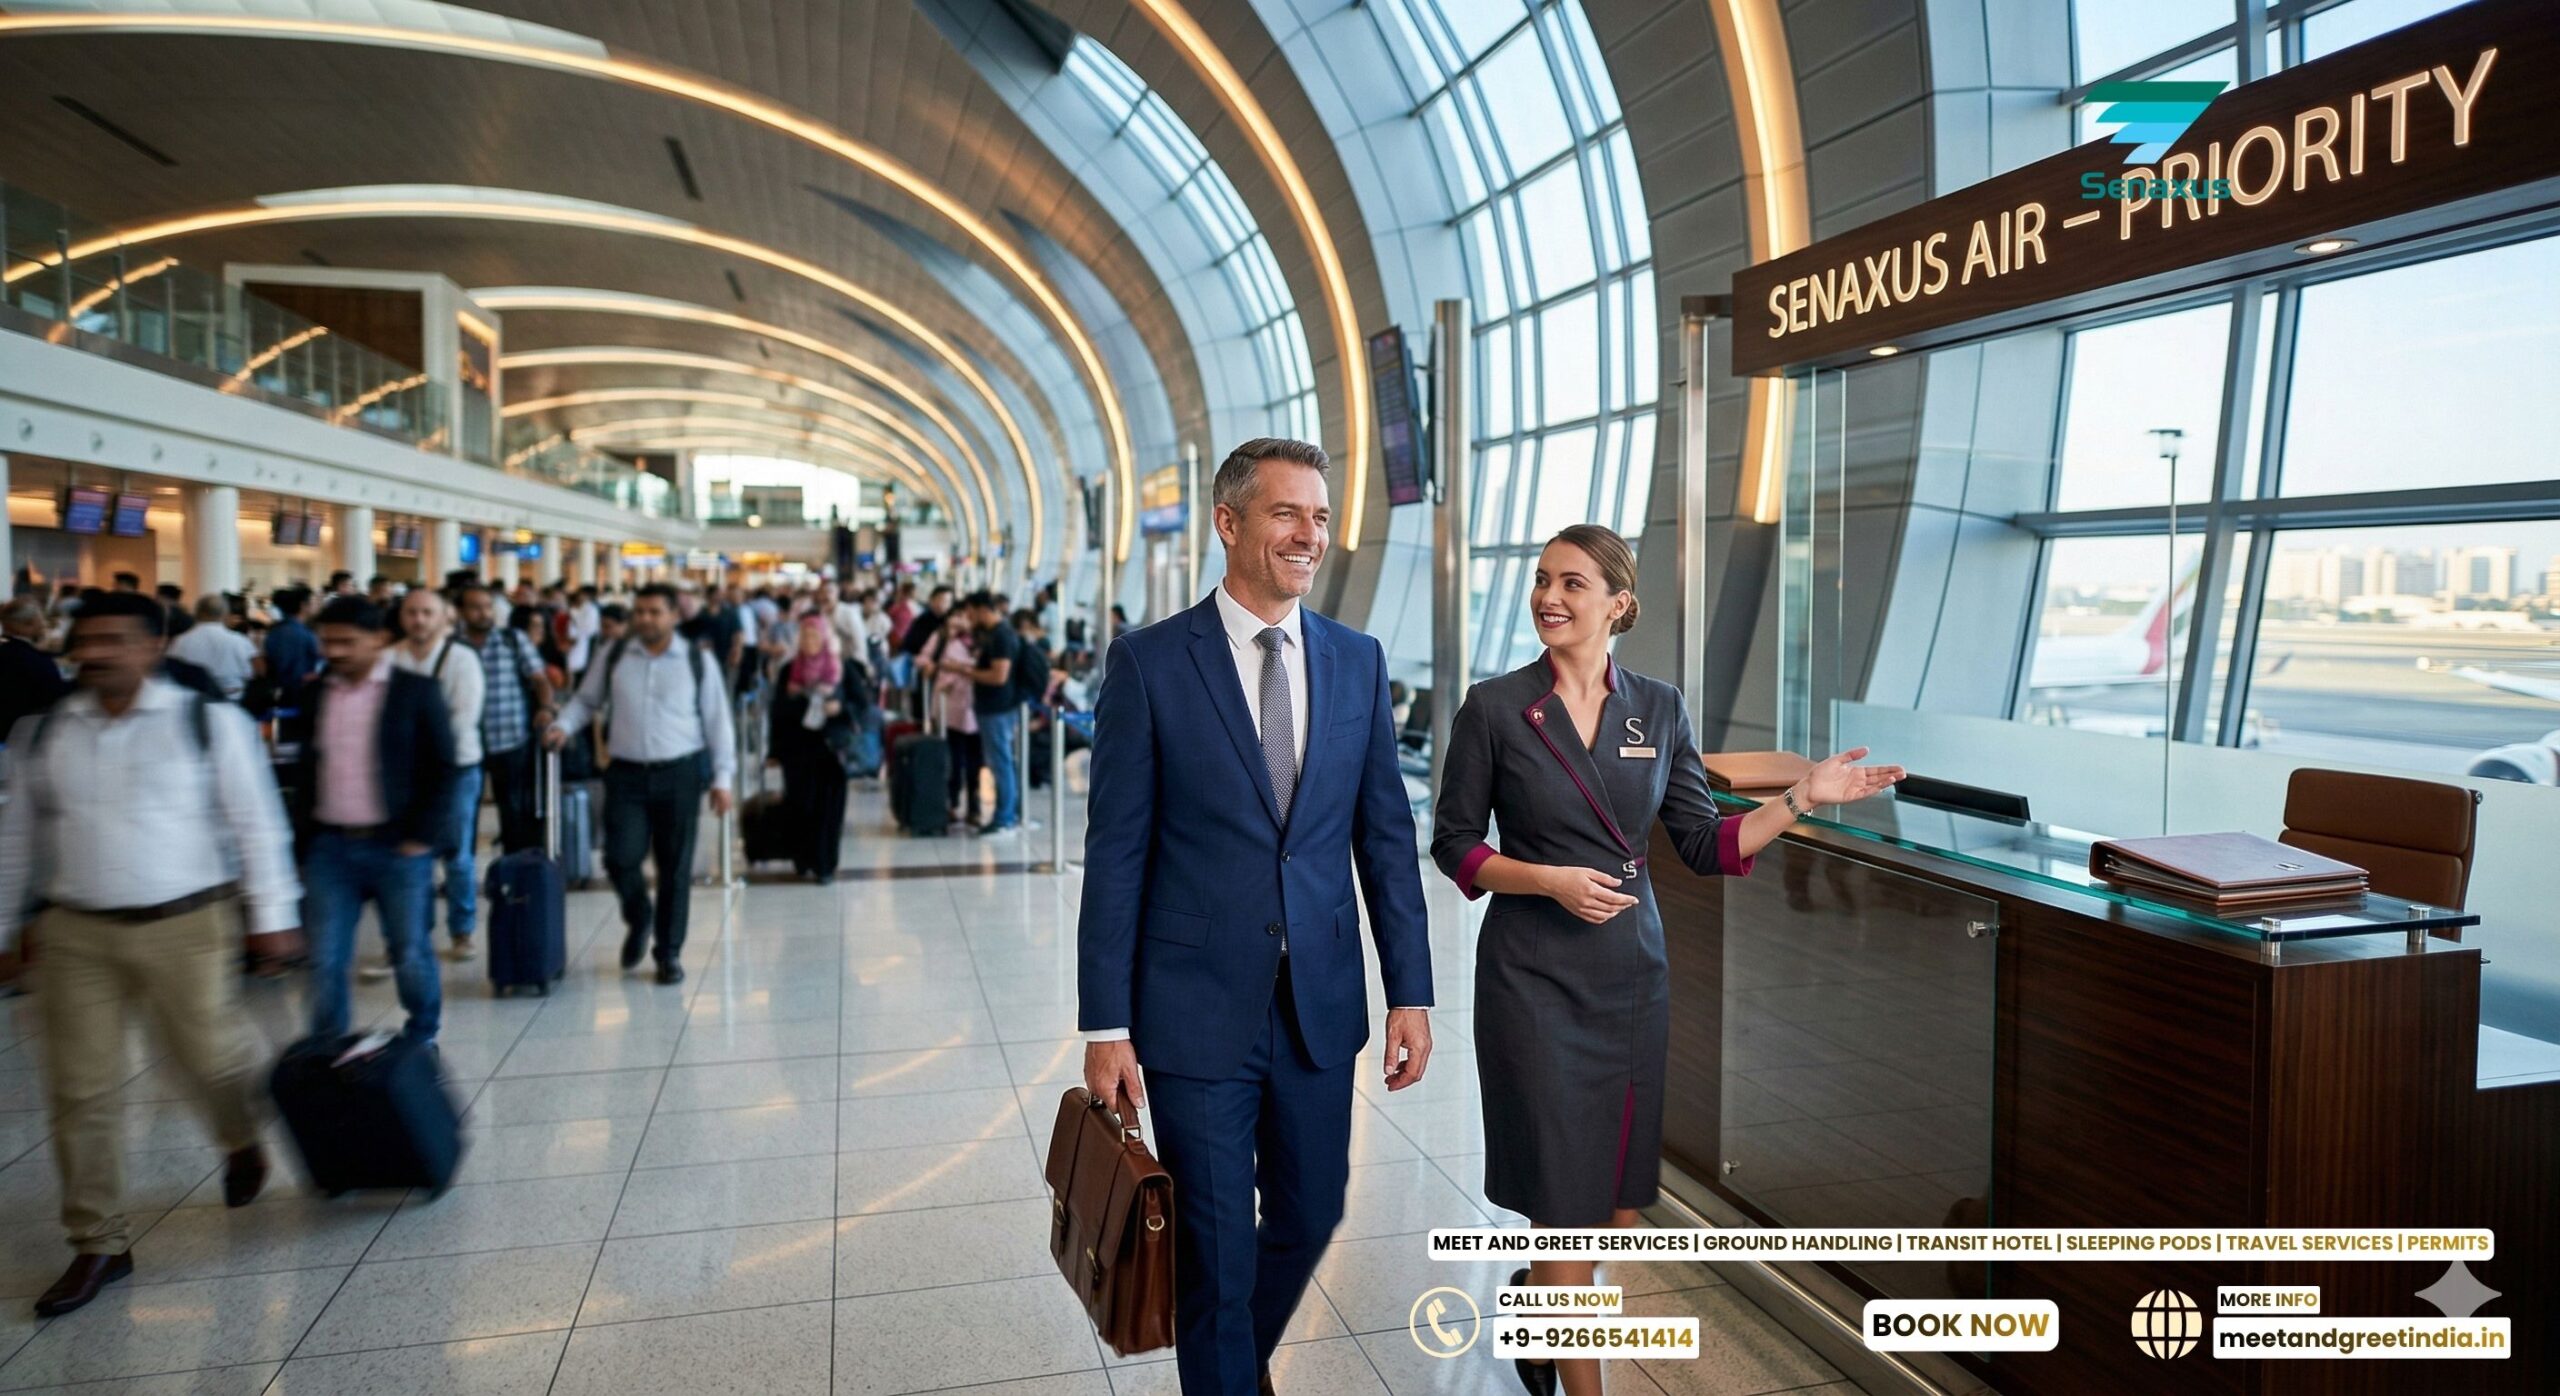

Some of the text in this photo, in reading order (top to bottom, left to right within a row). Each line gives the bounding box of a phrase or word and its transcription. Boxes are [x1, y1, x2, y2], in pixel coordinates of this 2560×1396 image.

[1768, 231, 1949, 338] SENAXUS
[1961, 203, 2047, 285] AIR
[2120, 48, 2498, 241] PRIORITY
[1625, 717, 1645, 744] S
